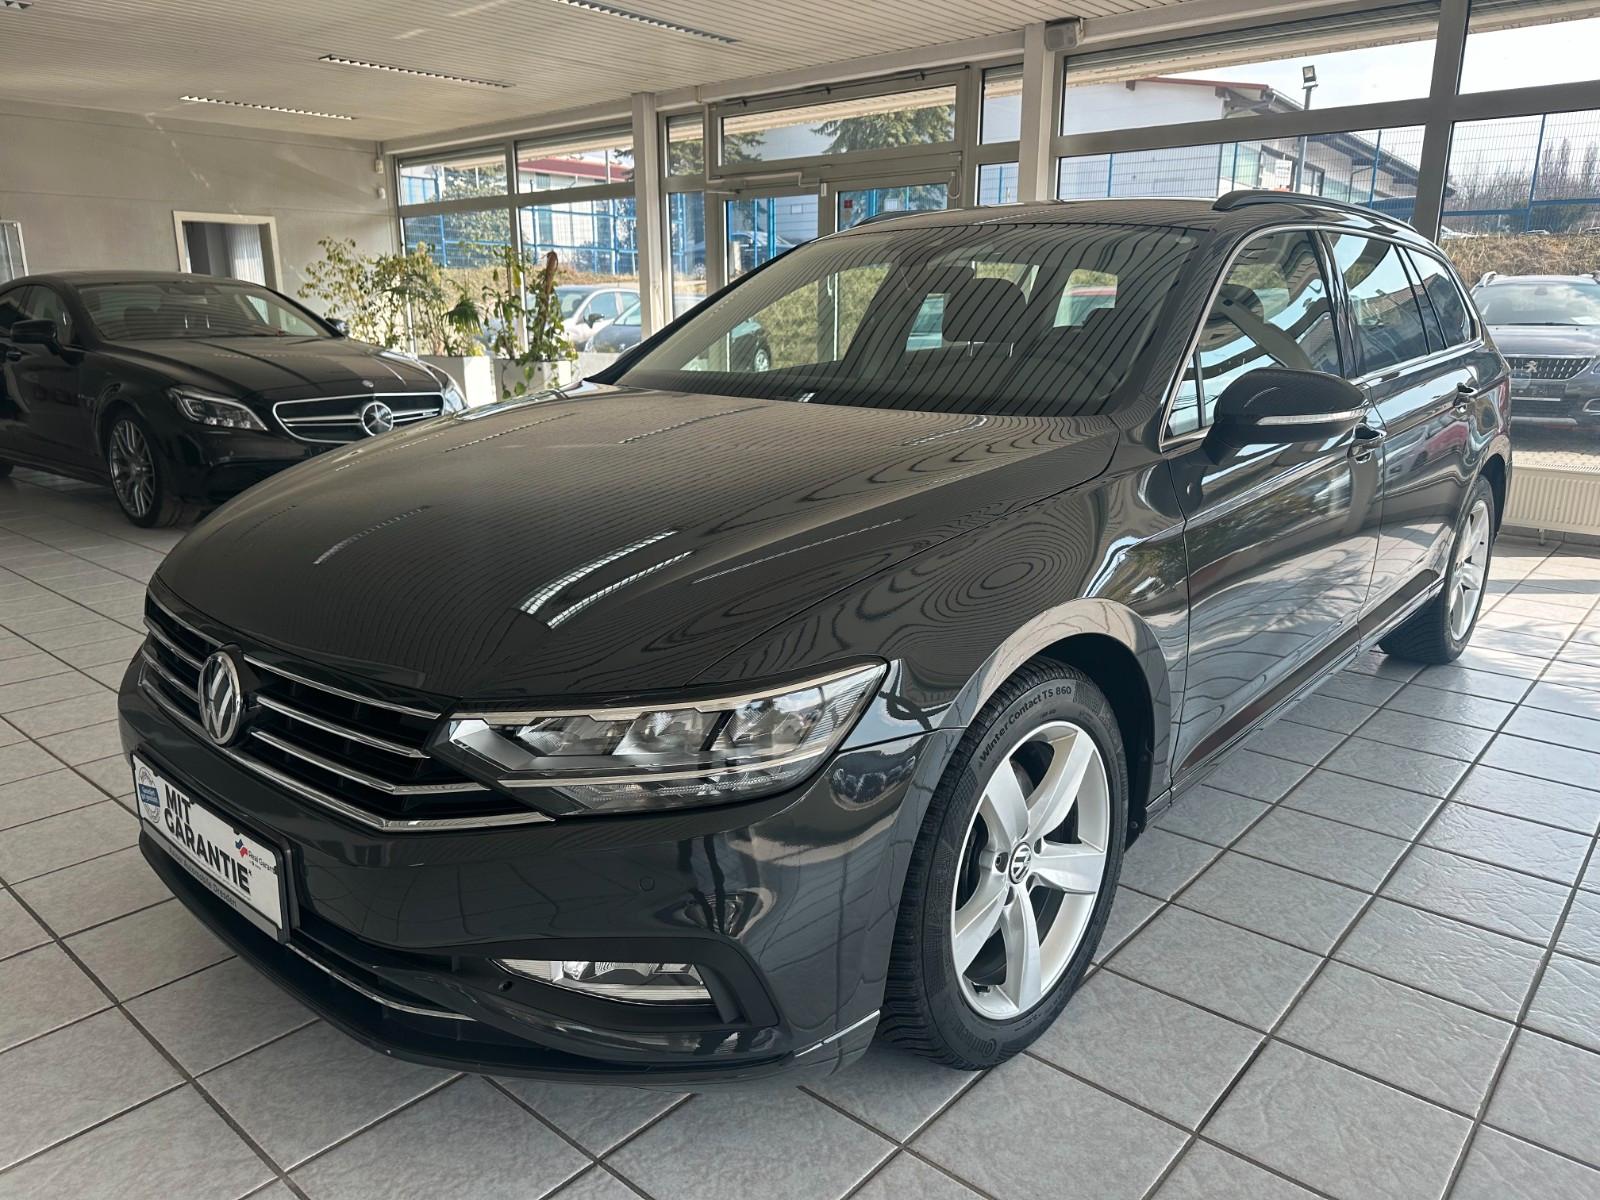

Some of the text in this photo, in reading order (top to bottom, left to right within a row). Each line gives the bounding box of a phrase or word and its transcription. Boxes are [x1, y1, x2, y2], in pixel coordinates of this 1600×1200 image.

[1042, 688, 1054, 700] TS
[1055, 686, 1073, 696] 860
[165, 784, 192, 825] MIT
